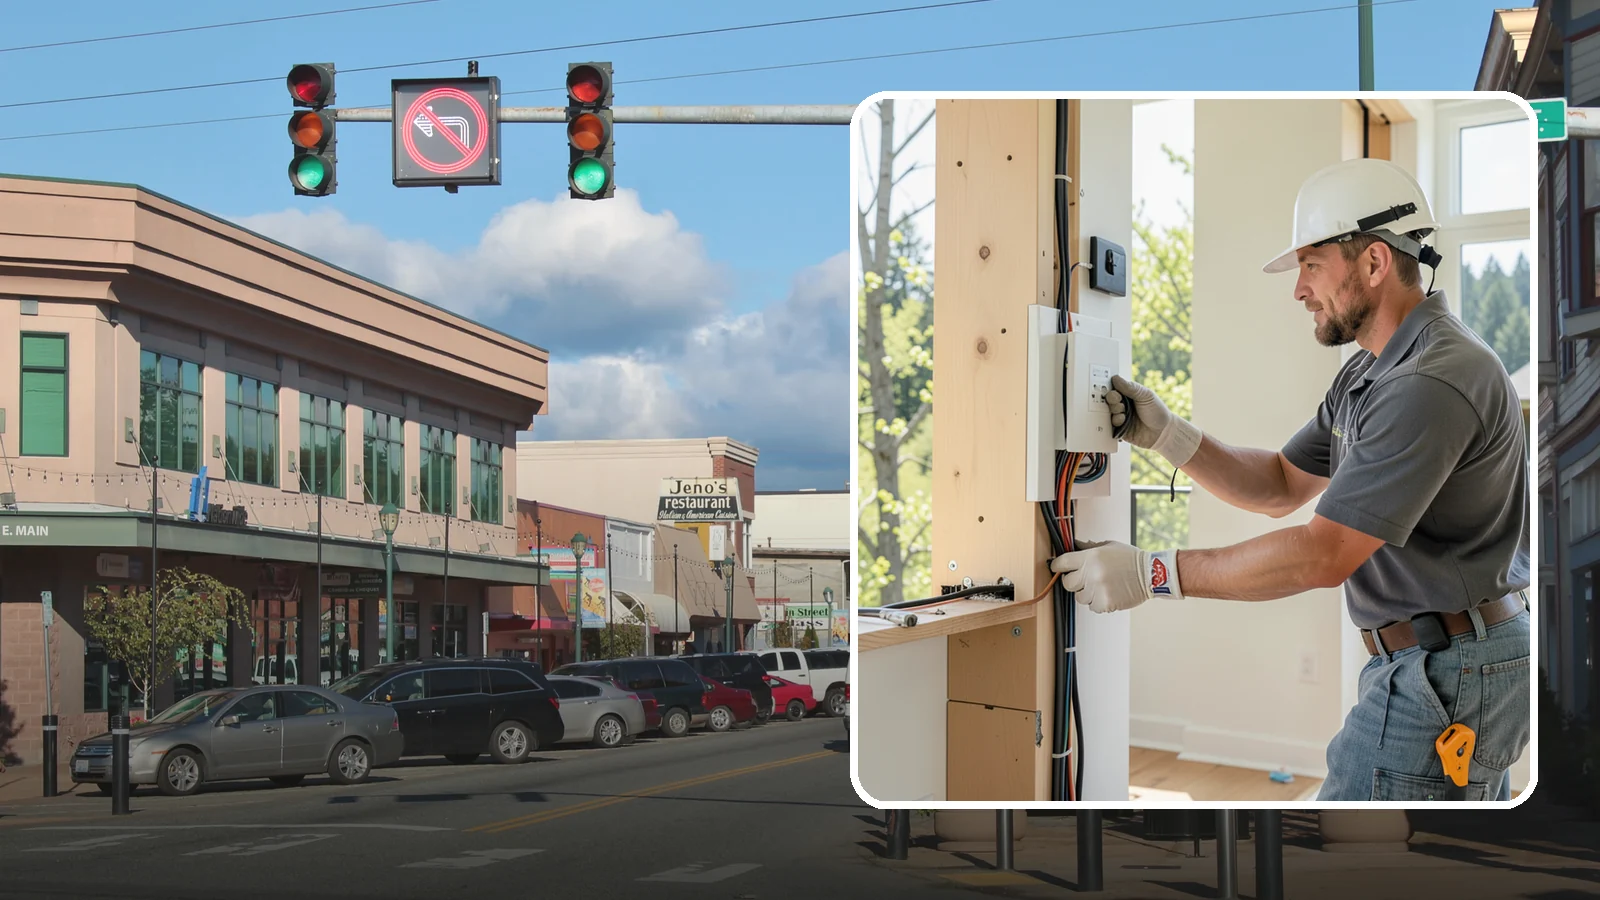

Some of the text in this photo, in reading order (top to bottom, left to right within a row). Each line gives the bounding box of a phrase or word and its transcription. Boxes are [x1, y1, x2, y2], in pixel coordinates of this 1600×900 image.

[670, 480, 727, 494] Jeno's
[665, 496, 731, 509] restaurant
[658, 509, 681, 519] Italian
[686, 509, 715, 519] American
[715, 509, 737, 519] Cuisine
[2, 525, 49, 537] E. MAIN
[797, 607, 828, 617] Street
